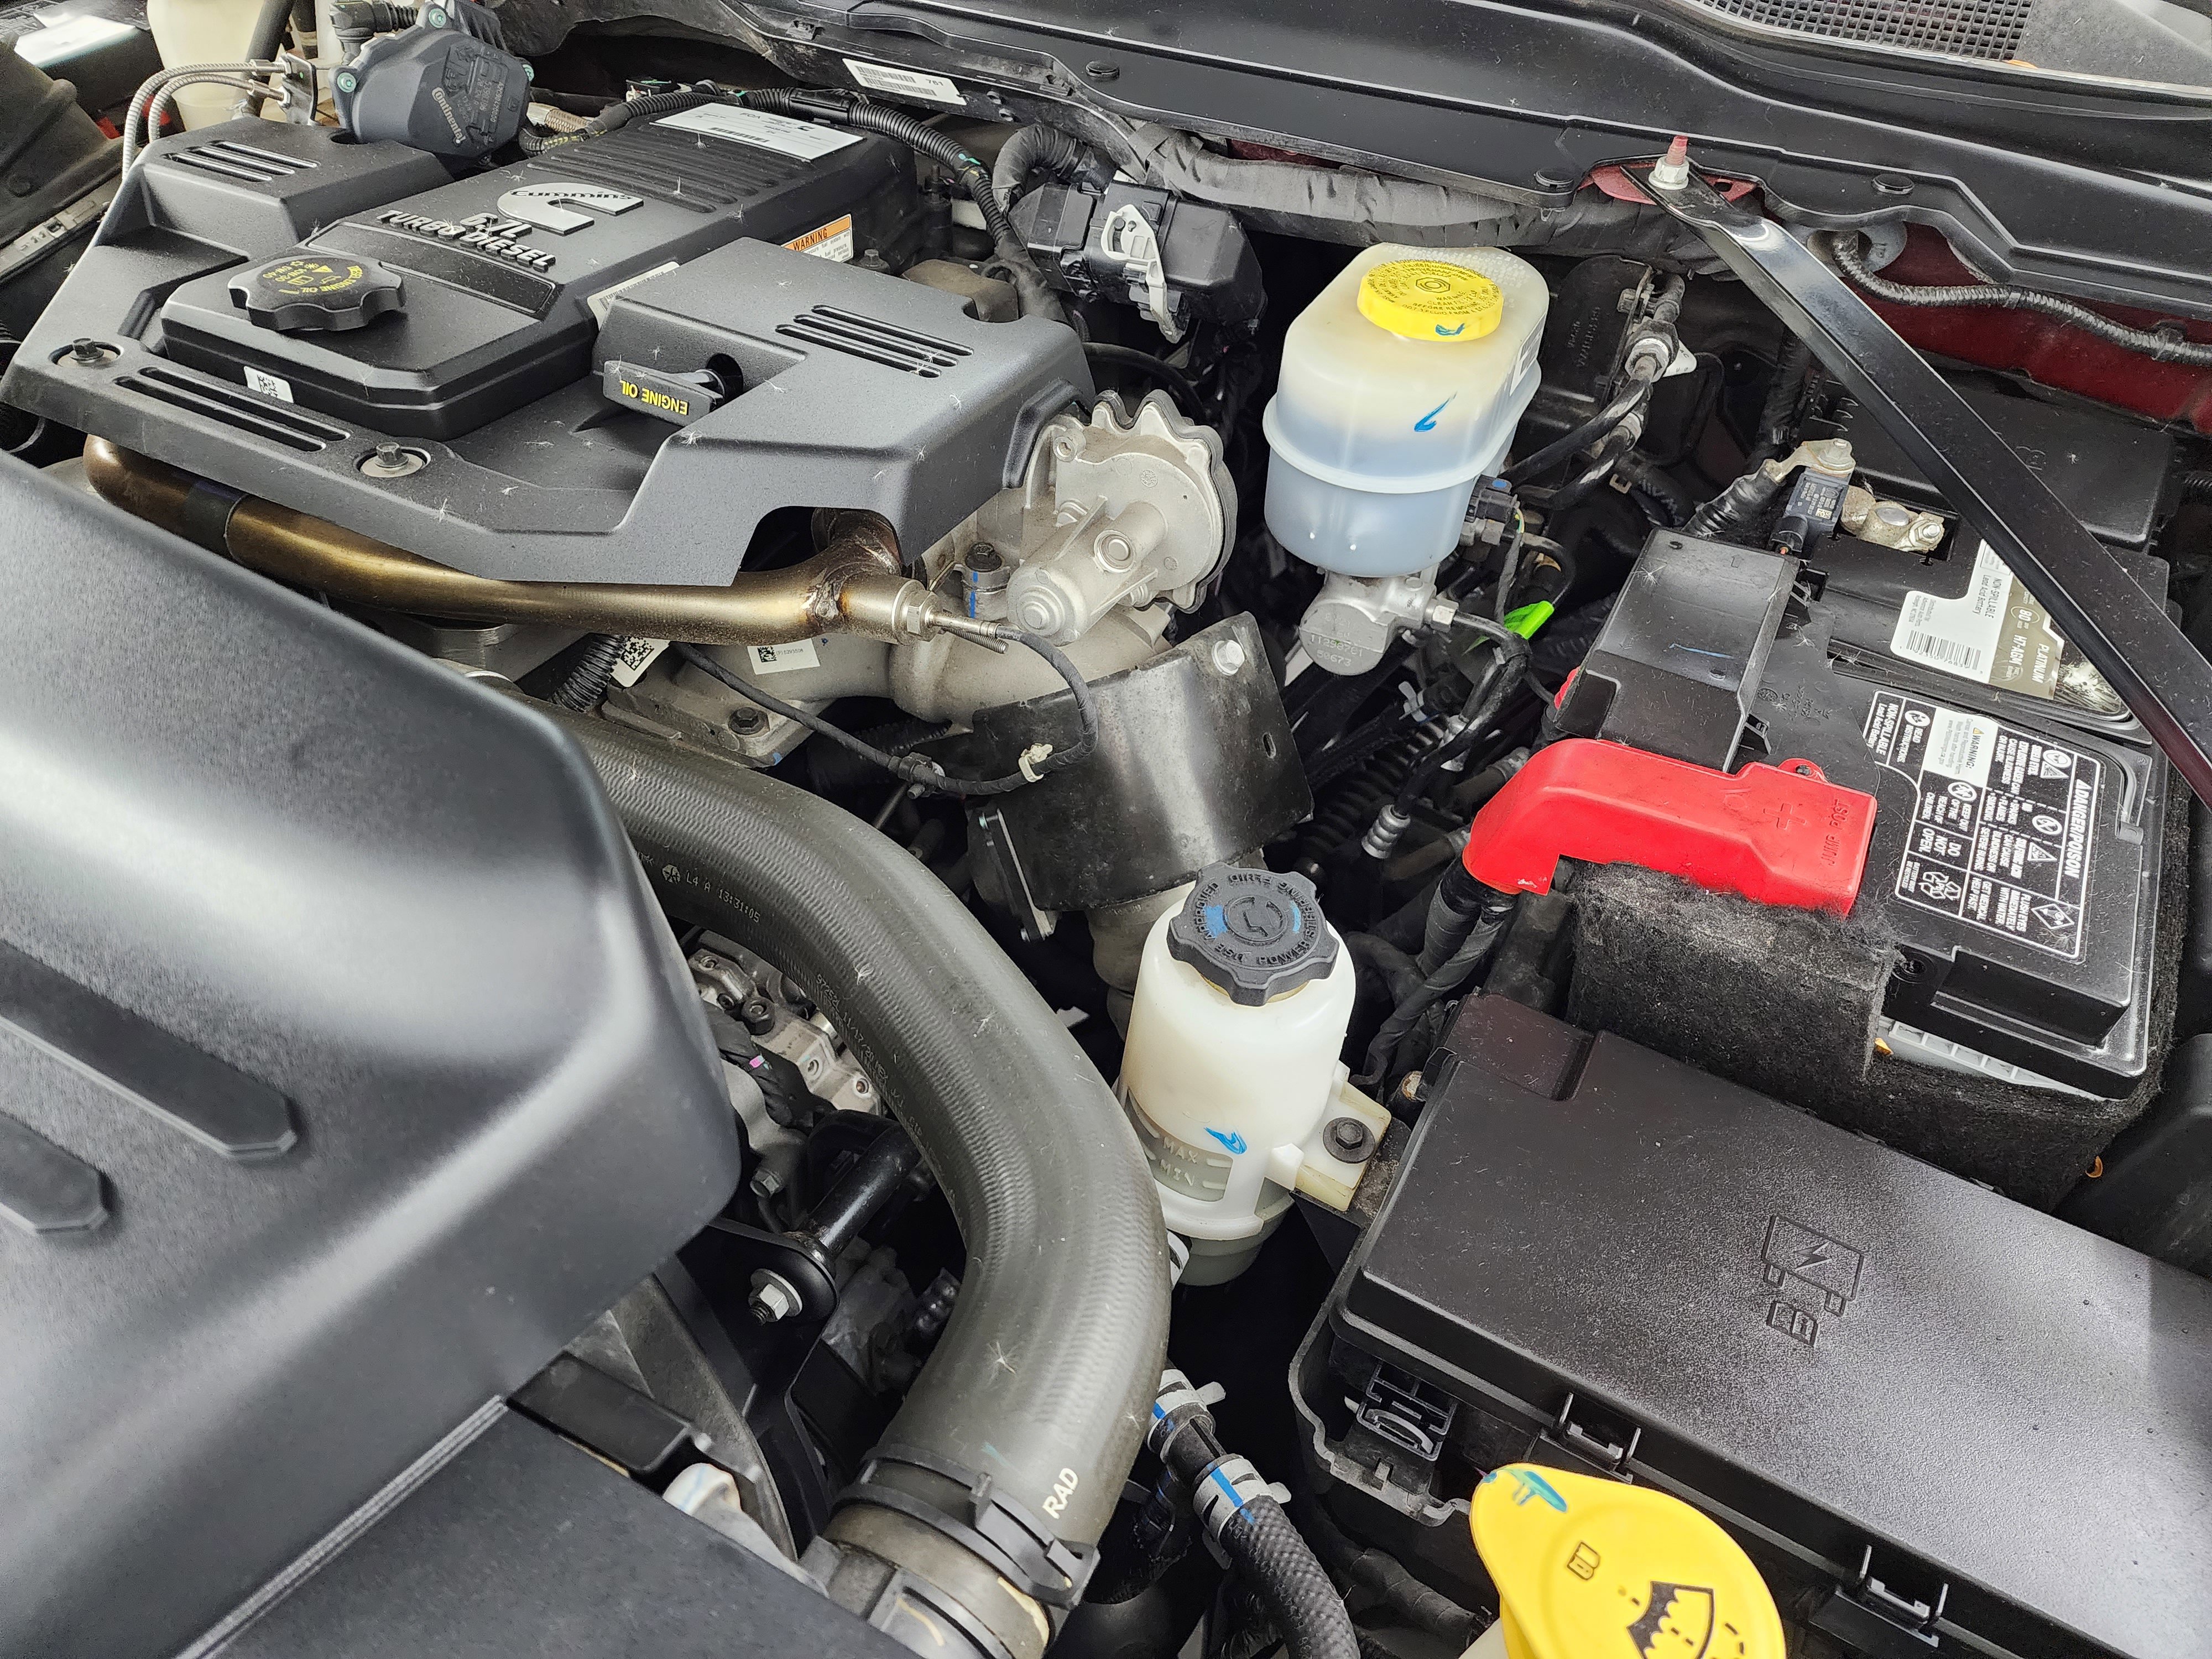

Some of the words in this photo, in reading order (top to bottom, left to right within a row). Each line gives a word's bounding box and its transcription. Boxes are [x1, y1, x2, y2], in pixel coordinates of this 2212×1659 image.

[431, 87, 466, 142] Continental
[510, 190, 633, 200] Cummins
[377, 210, 467, 239] TURBO
[459, 231, 556, 271] DIESEL
[793, 228, 827, 251] WARNING
[320, 279, 357, 292] ENGINE
[619, 379, 639, 399] OIL
[641, 388, 689, 416] ENGINE
[1984, 577, 2003, 619] NON-SPILLABLE
[2018, 609, 2033, 622] 80
[2008, 634, 2028, 666] H7-AGM
[2032, 643, 2050, 684] PLATINUM
[1872, 716, 1884, 730] Acid
[1876, 703, 1887, 718] Lead
[1867, 728, 1880, 749] Battery
[1876, 703, 1899, 756] NON-SPILLABLE
[1912, 727, 1923, 743] READ
[1965, 734, 1981, 769] WARNING:
[1829, 799, 1852, 830] POST
[1961, 803, 1973, 820] KEEP
[1918, 828, 1936, 853] OPEN.
[1933, 835, 1948, 857] NOT
[2064, 789, 2090, 879] DANGER/POISON
[1821, 833, 1840, 867] JUMP
[1947, 842, 1962, 858] DO
[686, 870, 699, 887] L4
[718, 889, 761, 924] 13:31:05
[1970, 877, 1982, 894] HELP
[1981, 880, 1992, 895] GET
[1999, 887, 2011, 905] WITH
[1976, 893, 1990, 921] MEDICAL
[2019, 893, 2032, 915] FLUSH
[1256, 940, 1311, 966] POWER
[1162, 1136, 1199, 1165] MAX
[1160, 1159, 1196, 1187] MIN
[1042, 1468, 1078, 1520] RAD
